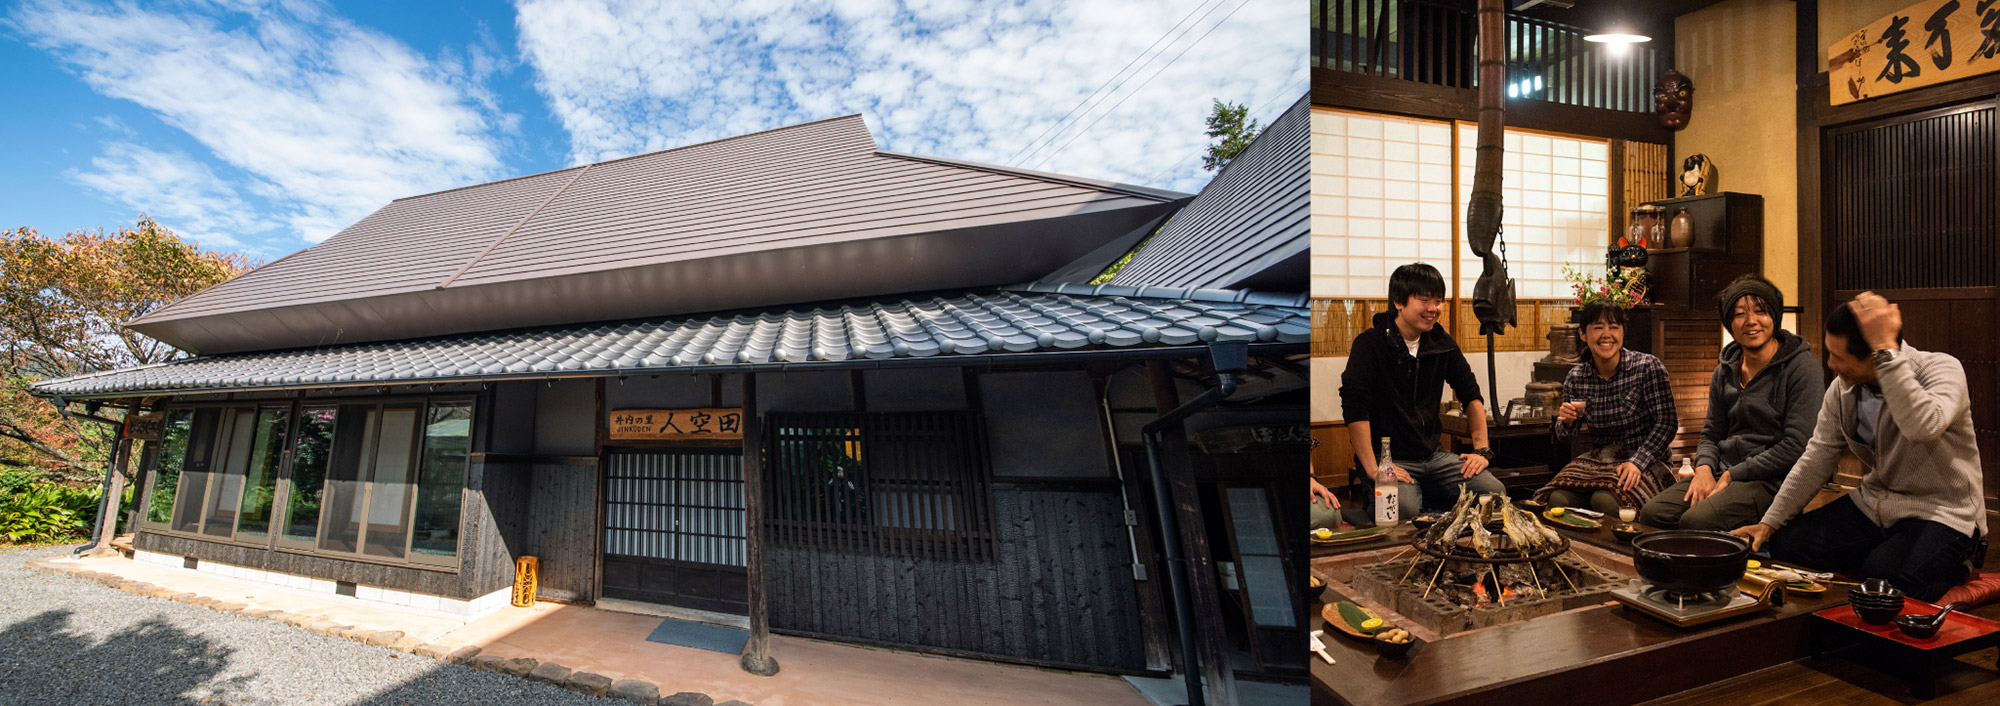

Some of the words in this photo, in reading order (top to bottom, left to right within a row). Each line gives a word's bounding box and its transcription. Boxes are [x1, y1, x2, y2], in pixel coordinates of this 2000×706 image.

[615, 414, 654, 425] 井内の里
[660, 412, 741, 434] 人空田
